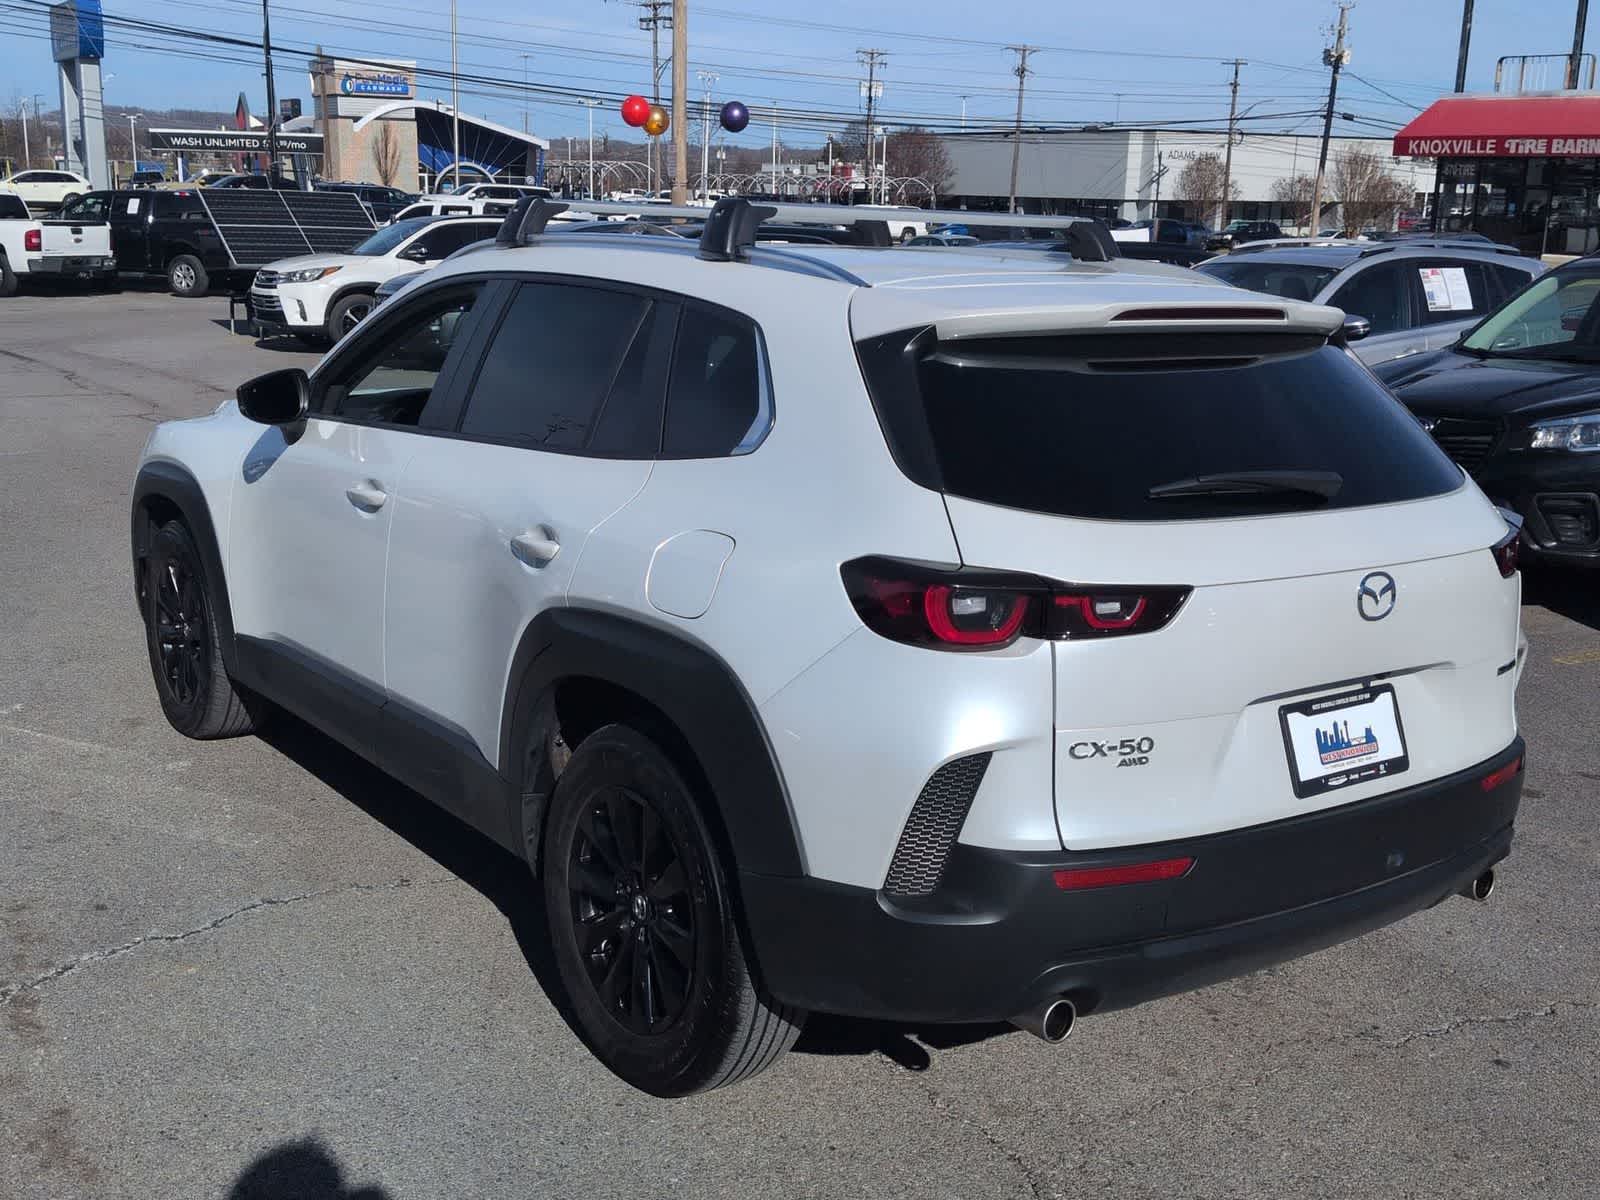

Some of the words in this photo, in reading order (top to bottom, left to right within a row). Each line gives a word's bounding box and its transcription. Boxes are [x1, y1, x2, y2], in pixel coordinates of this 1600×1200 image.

[170, 136, 202, 147] WASH
[205, 137, 260, 148] UNLIMITED
[1408, 139, 1497, 154] KNOXVILLE
[1551, 138, 1600, 154] BARN
[1069, 737, 1154, 759] CX-50
[1116, 756, 1149, 768] AWD
